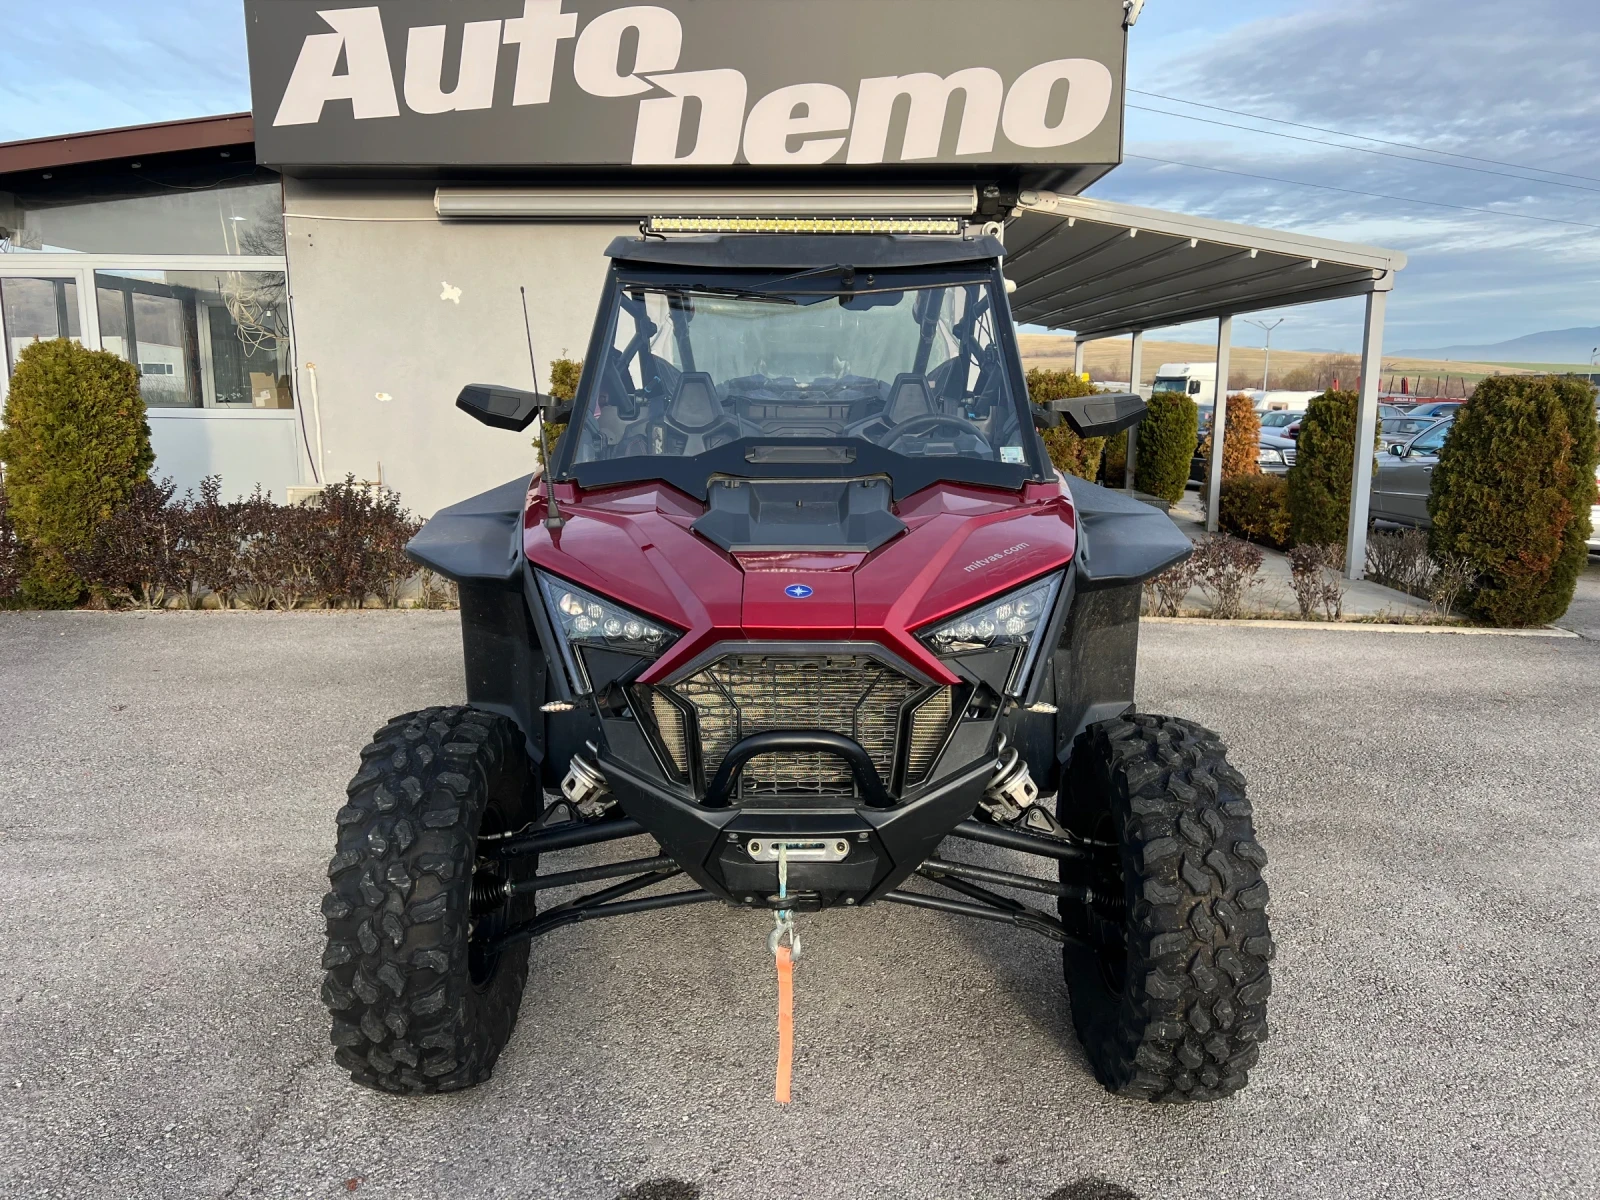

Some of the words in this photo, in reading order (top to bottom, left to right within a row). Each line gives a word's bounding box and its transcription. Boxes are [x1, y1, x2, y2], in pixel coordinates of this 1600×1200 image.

[273, 0, 683, 127] Auto
[631, 58, 1113, 165] Demo
[963, 542, 1030, 573] mitvas.com
